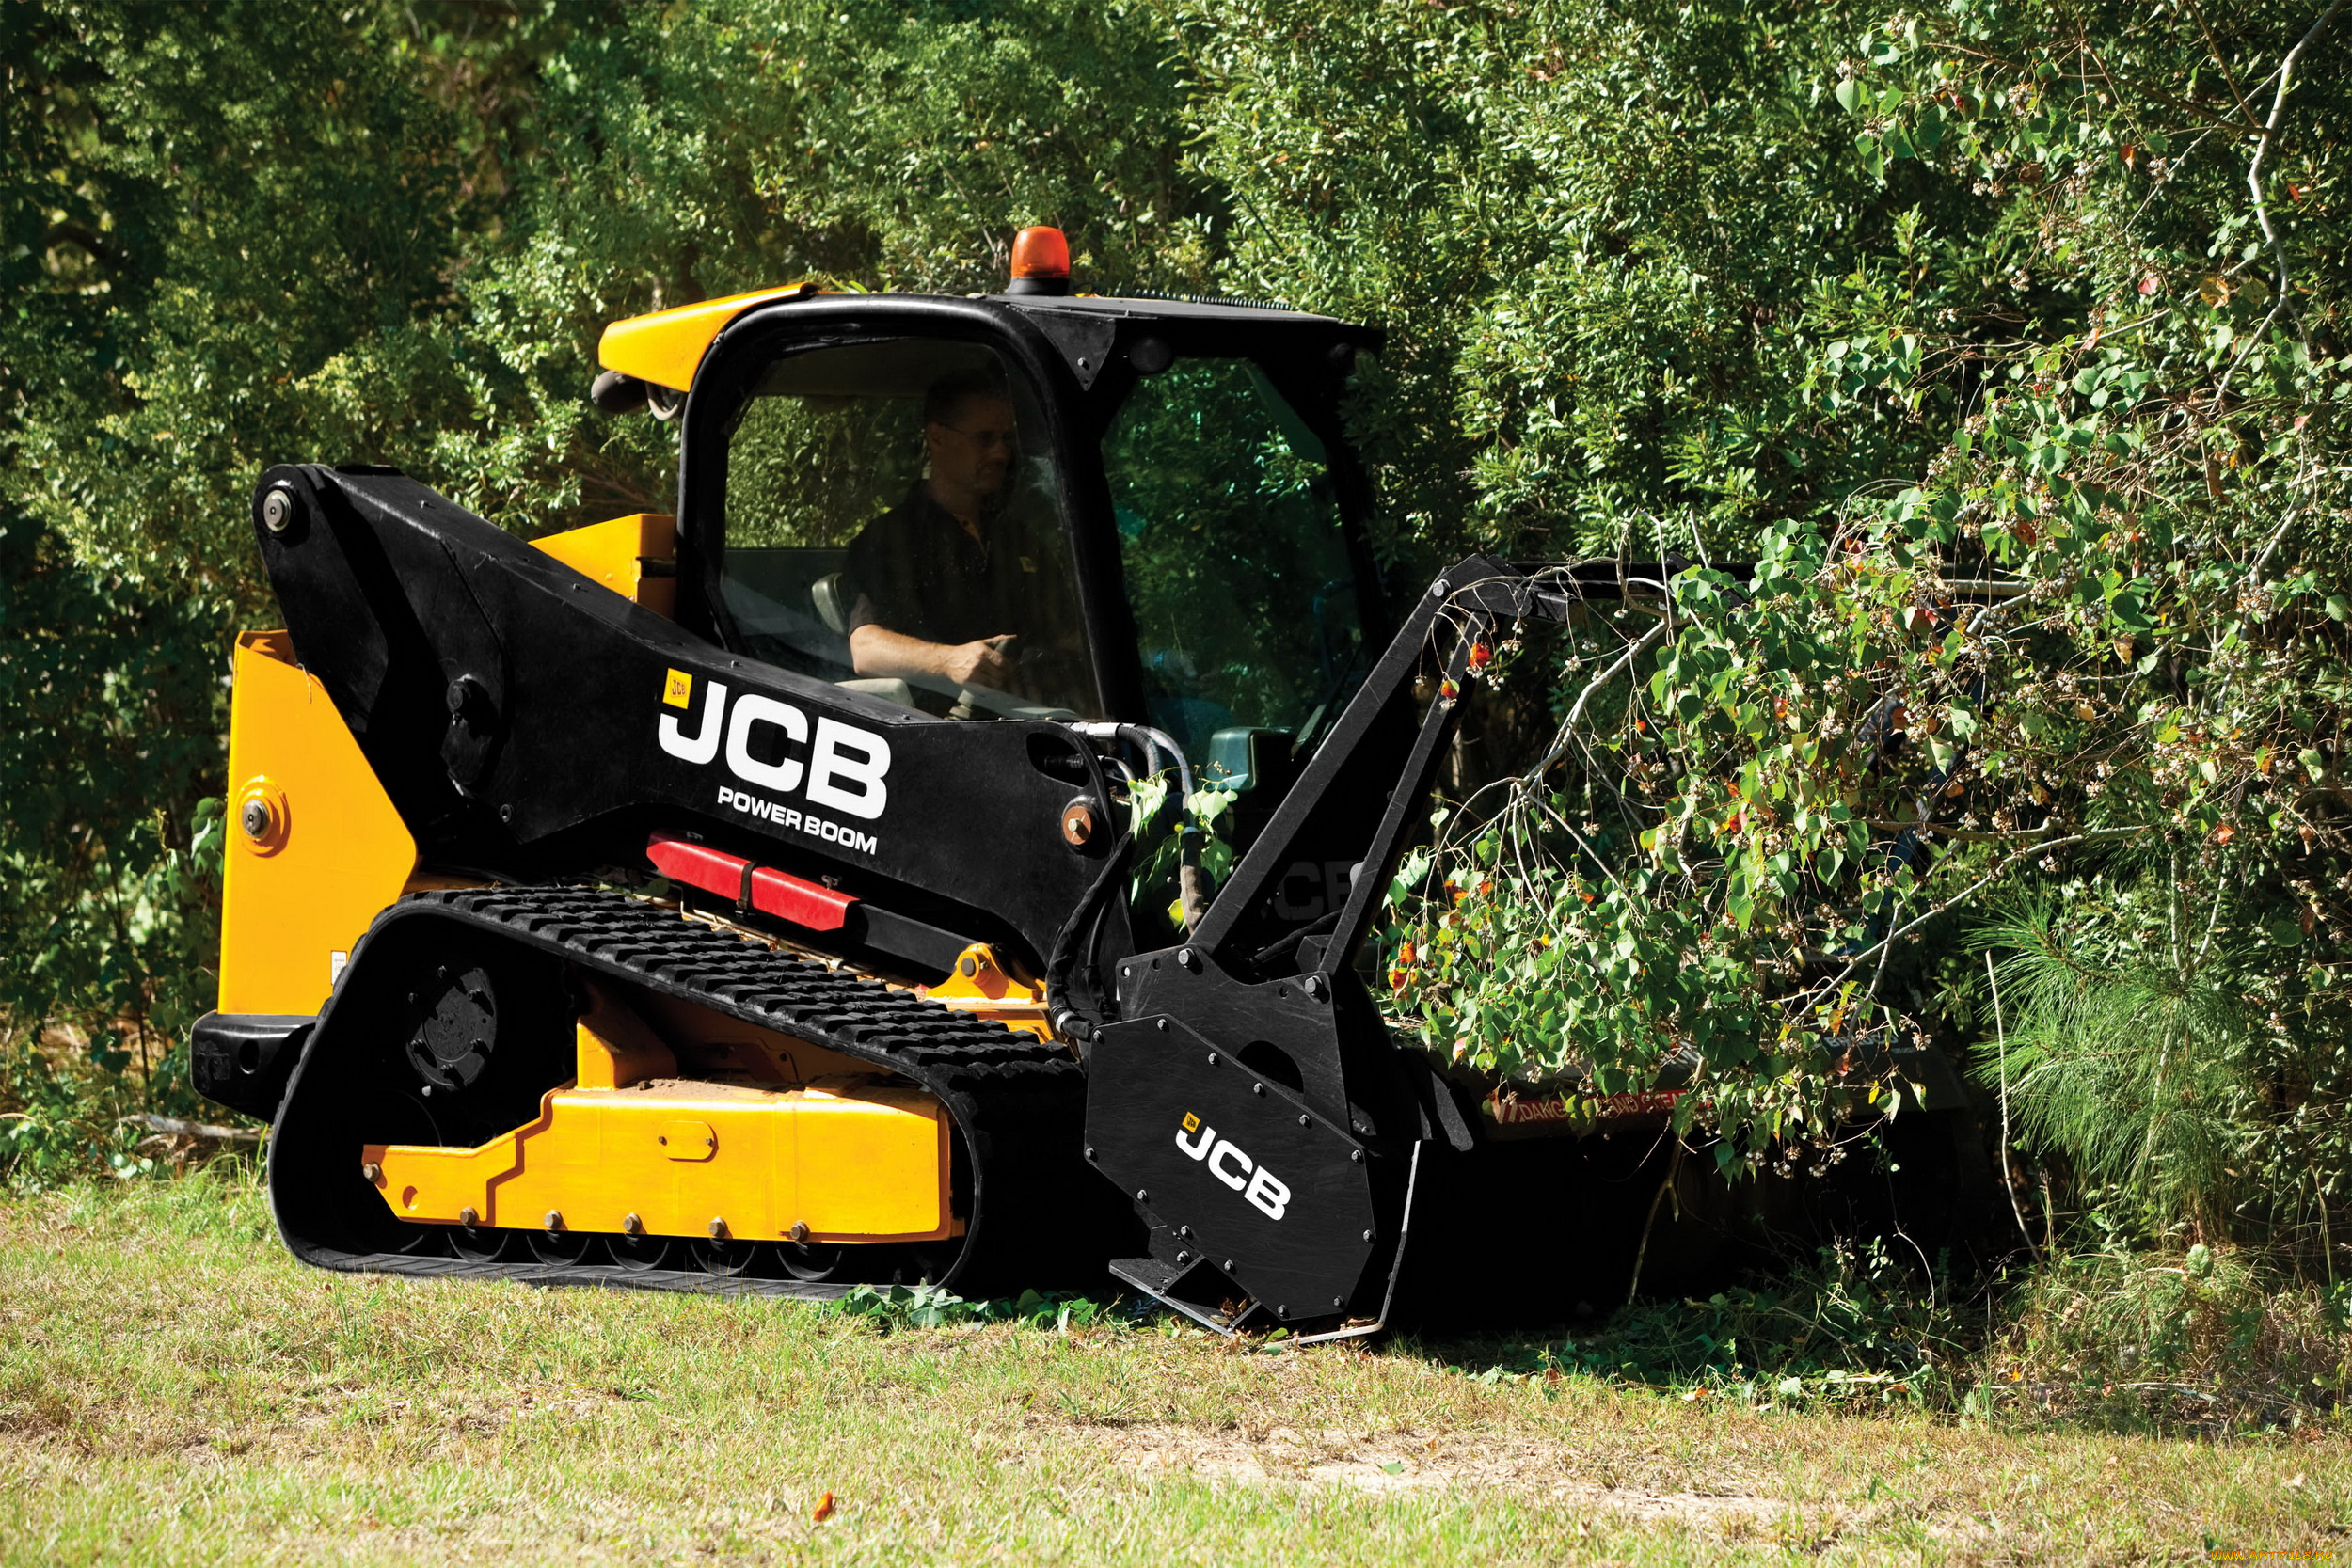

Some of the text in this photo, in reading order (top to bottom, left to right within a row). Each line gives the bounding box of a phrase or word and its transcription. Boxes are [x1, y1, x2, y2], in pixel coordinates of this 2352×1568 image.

[672, 679, 686, 696] JCB
[659, 680, 891, 819] JCB
[717, 786, 877, 855] POWER BOOM
[1518, 1100, 1566, 1121] DANG
[1175, 1126, 1291, 1221] JCB
